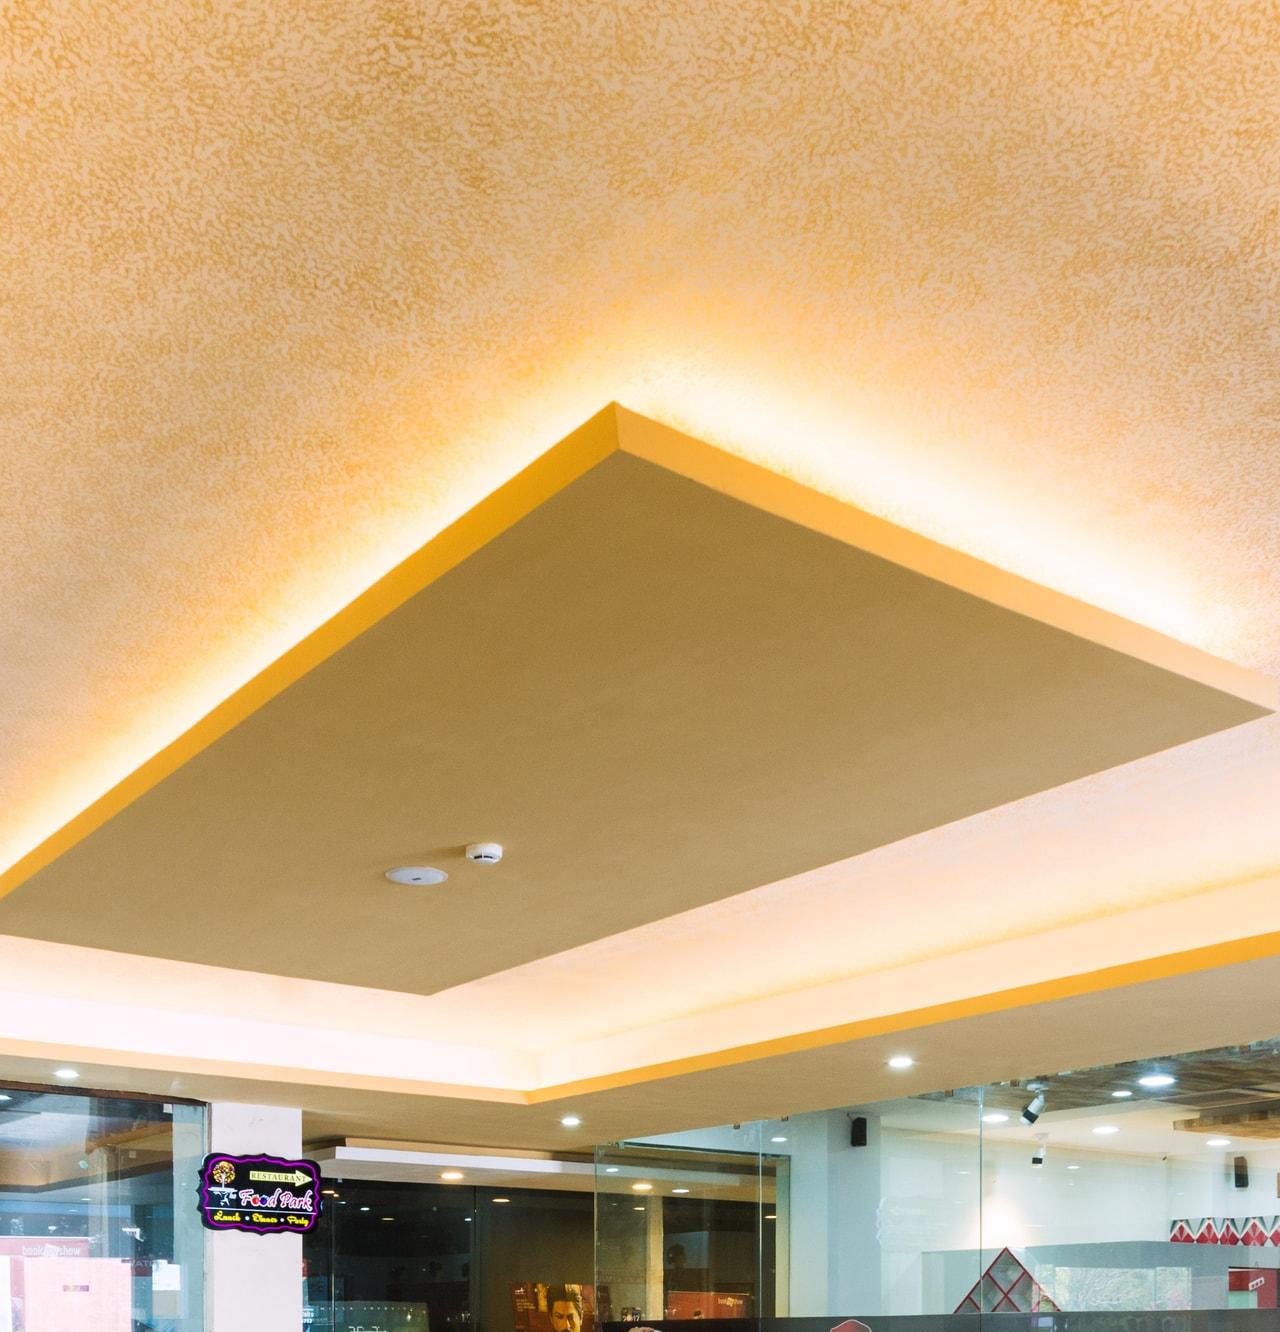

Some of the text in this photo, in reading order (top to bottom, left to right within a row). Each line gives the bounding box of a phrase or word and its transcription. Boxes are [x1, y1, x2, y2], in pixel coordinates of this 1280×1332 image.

[251, 1171, 306, 1182] RESTAURANT
[239, 1188, 313, 1212] Food Park
[214, 1210, 310, 1228] Lunch Dinner Party
